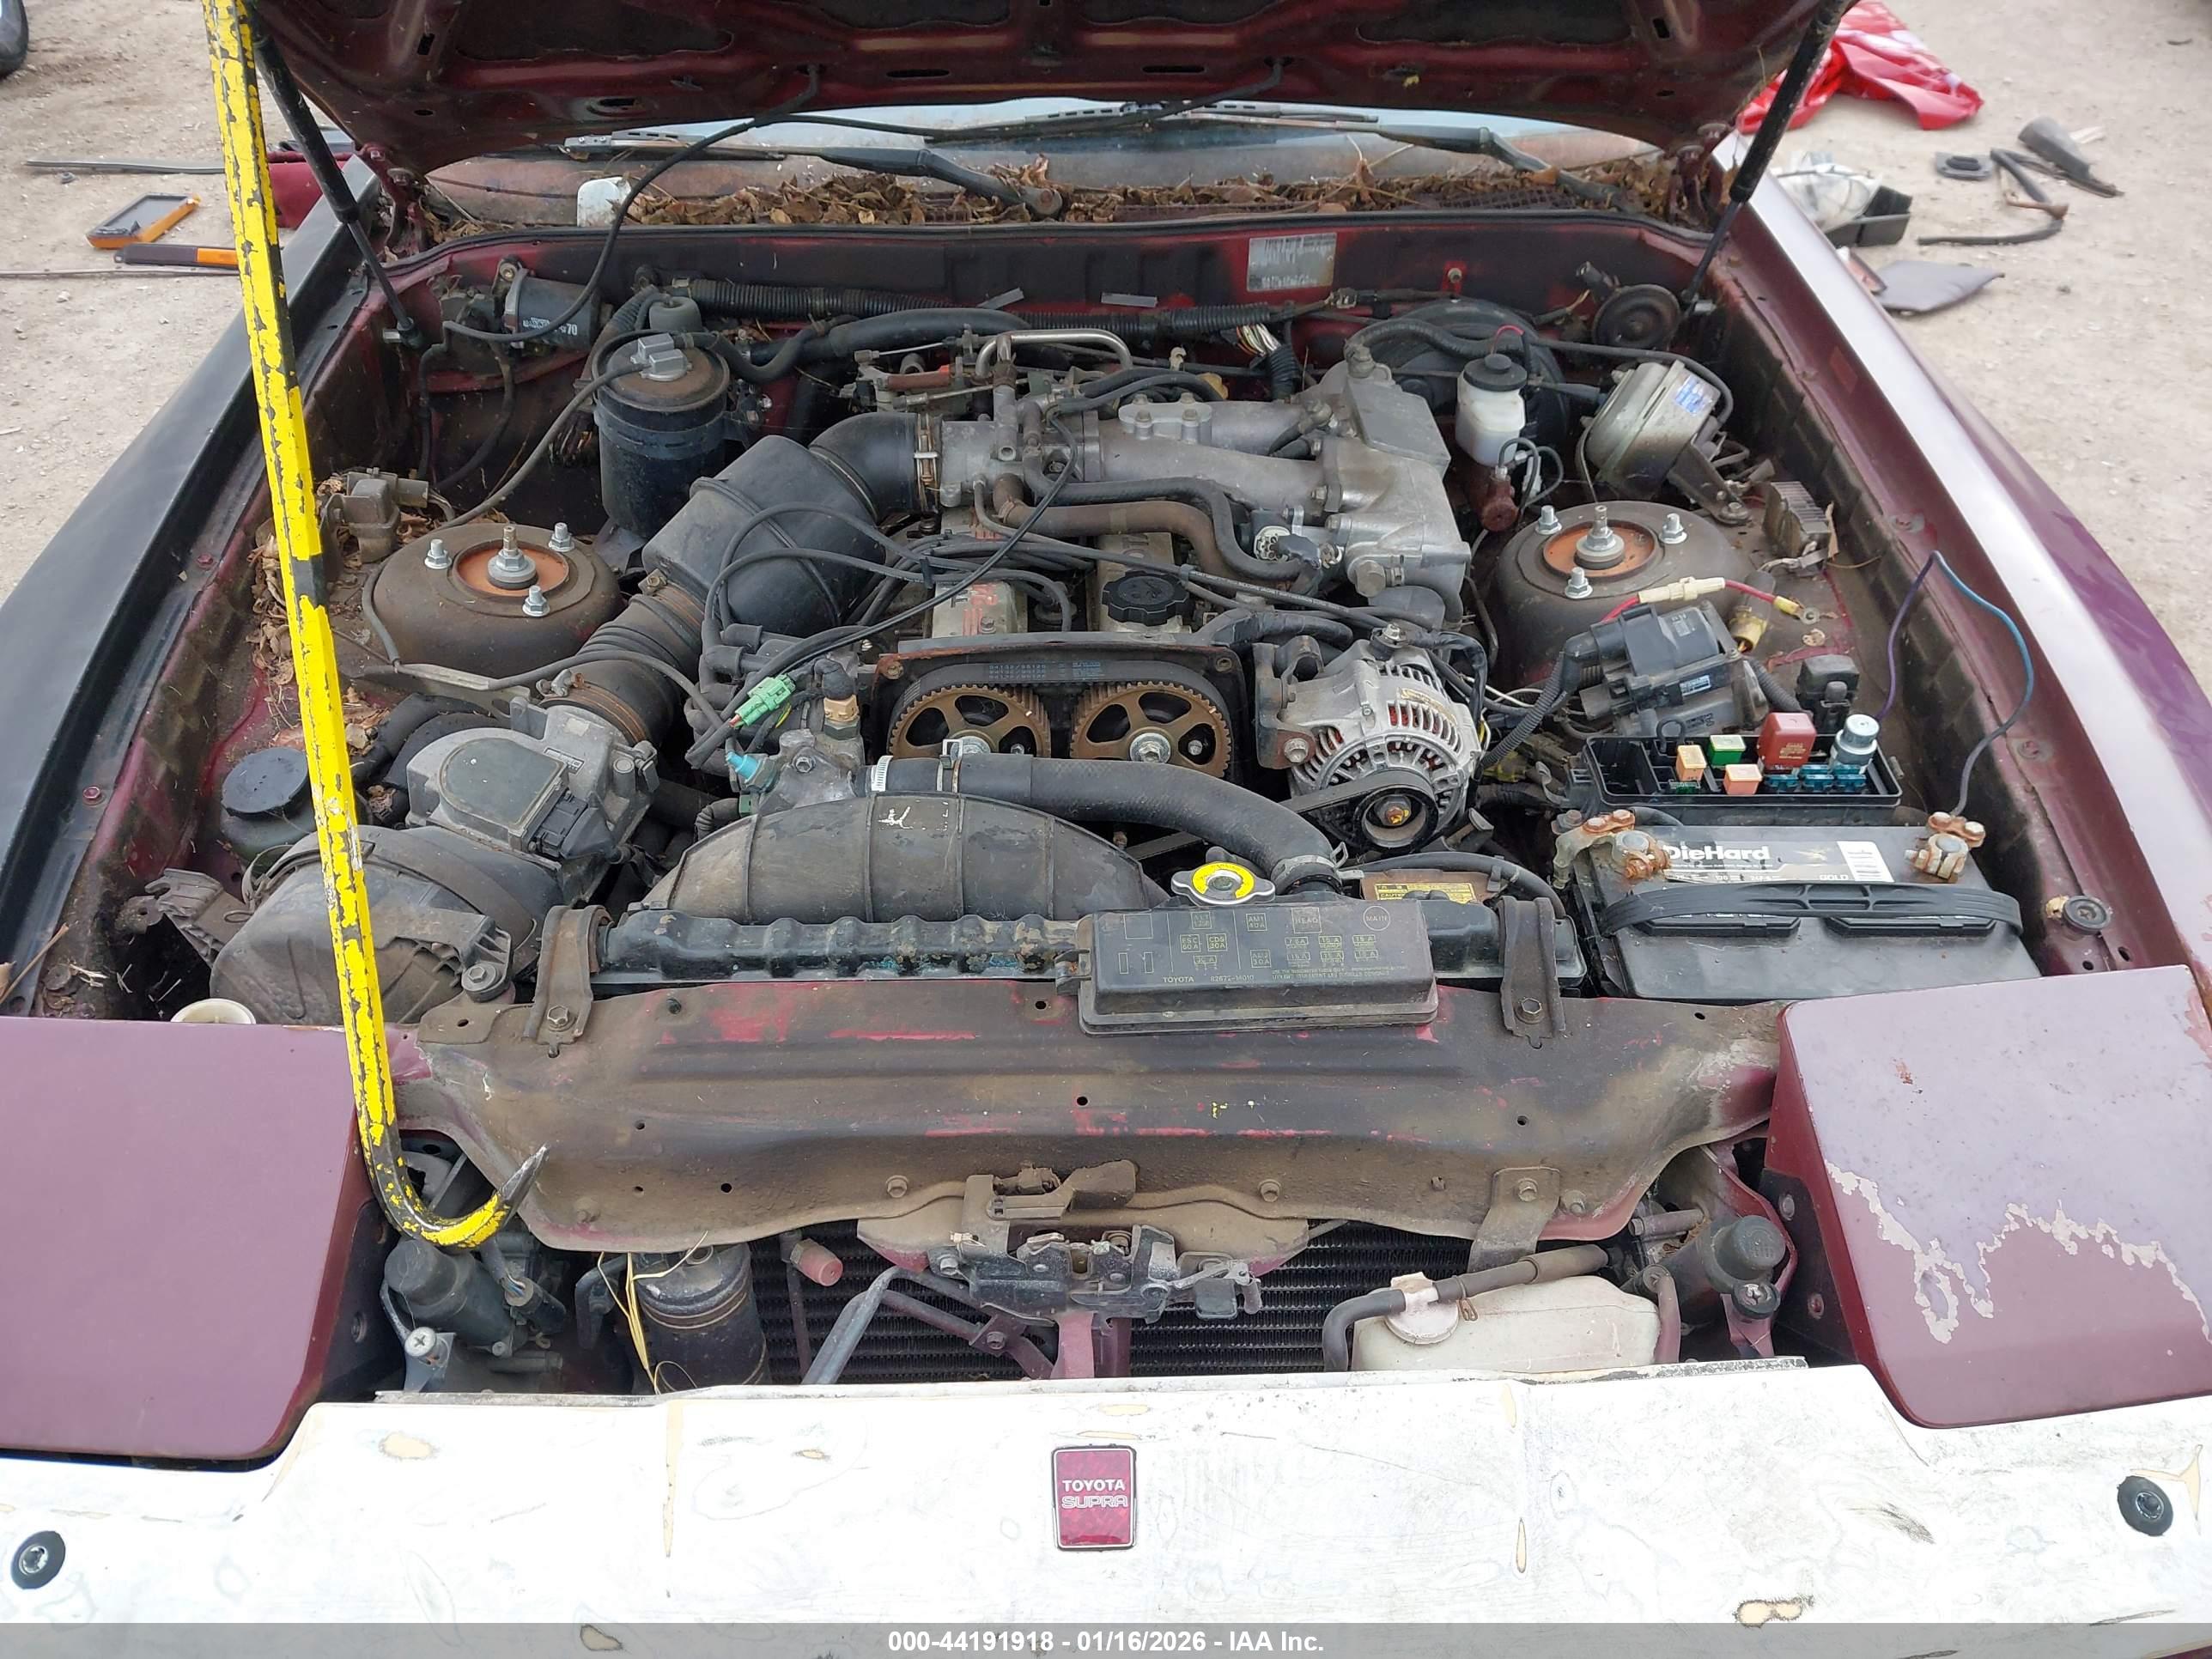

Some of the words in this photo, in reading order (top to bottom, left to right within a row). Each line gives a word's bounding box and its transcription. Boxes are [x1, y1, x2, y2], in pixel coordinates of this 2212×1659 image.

[566, 323, 578, 336] 70
[1663, 845, 1771, 860] DieHard
[1062, 1480, 1126, 1492] TOYOTA
[1061, 1495, 1127, 1509] SUPRA
